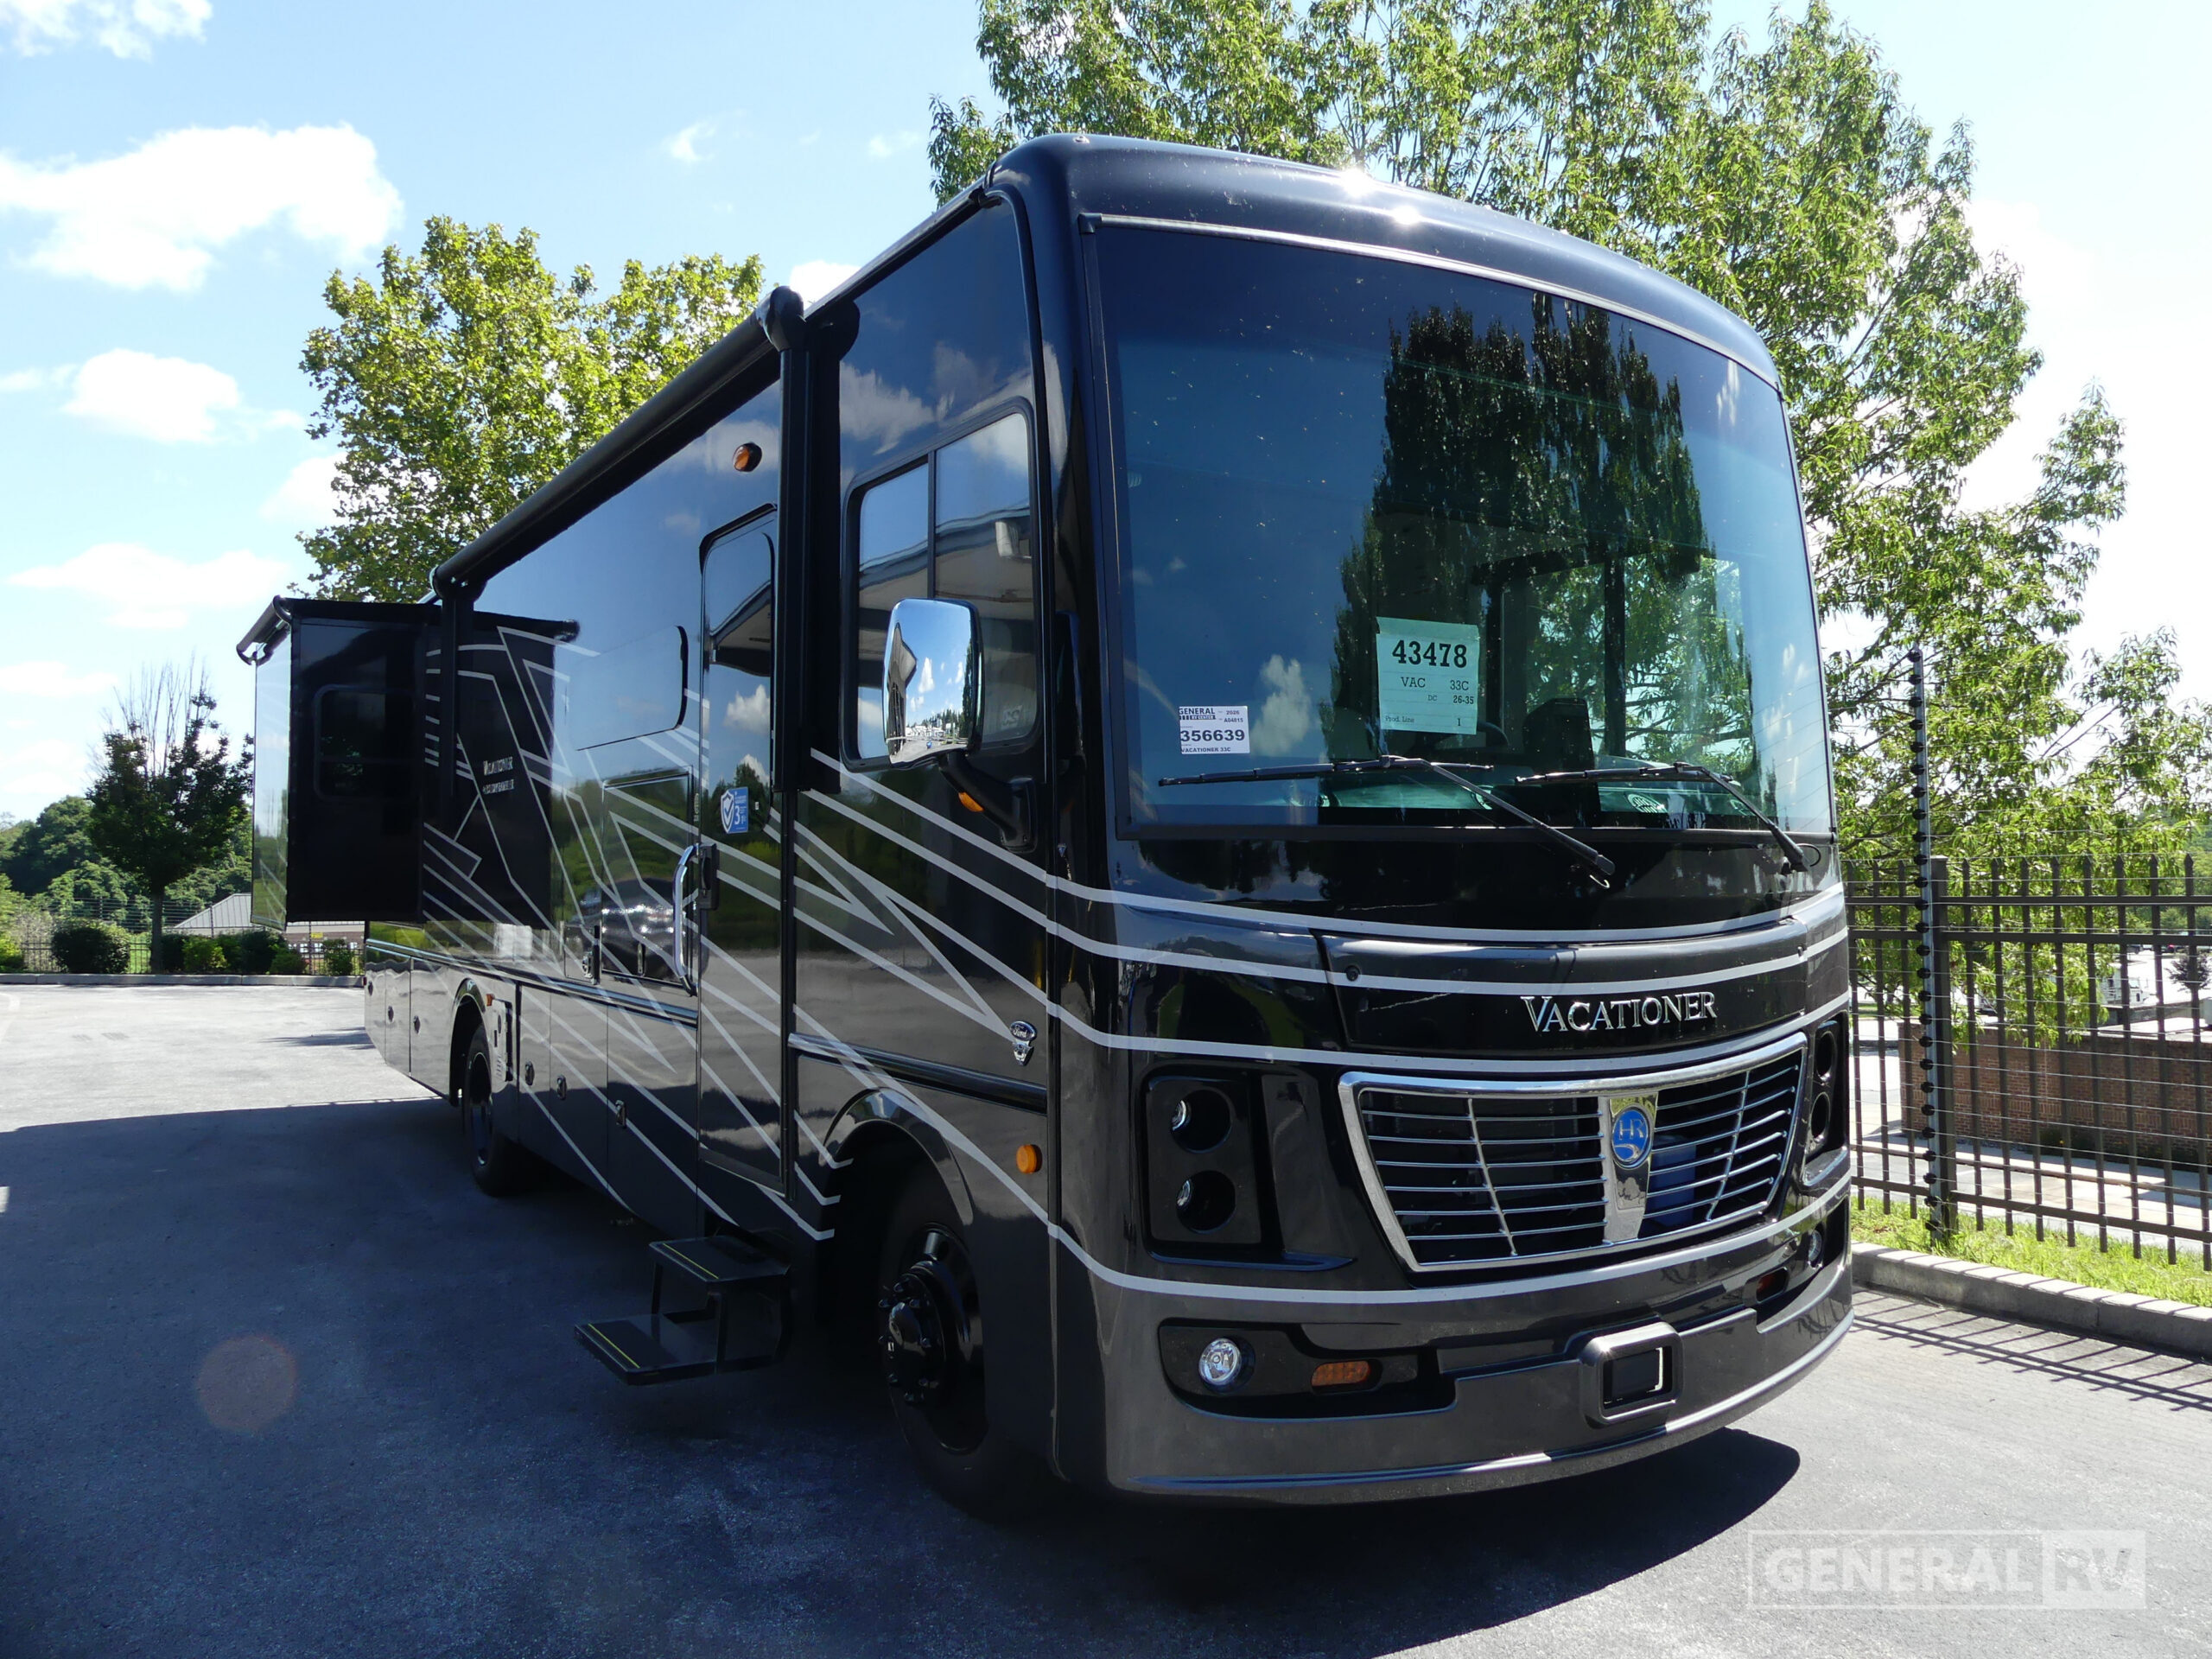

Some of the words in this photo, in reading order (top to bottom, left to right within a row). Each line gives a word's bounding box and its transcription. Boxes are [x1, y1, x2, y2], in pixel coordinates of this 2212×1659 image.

[1392, 639, 1467, 668] 43478
[1401, 677, 1426, 688] VAC
[1450, 680, 1469, 690] 33C
[1453, 695, 1474, 704] 26-35
[1180, 729, 1245, 742] 356639
[1520, 991, 1718, 1033] VACATIONER
[1014, 1024, 1028, 1038] Ford
